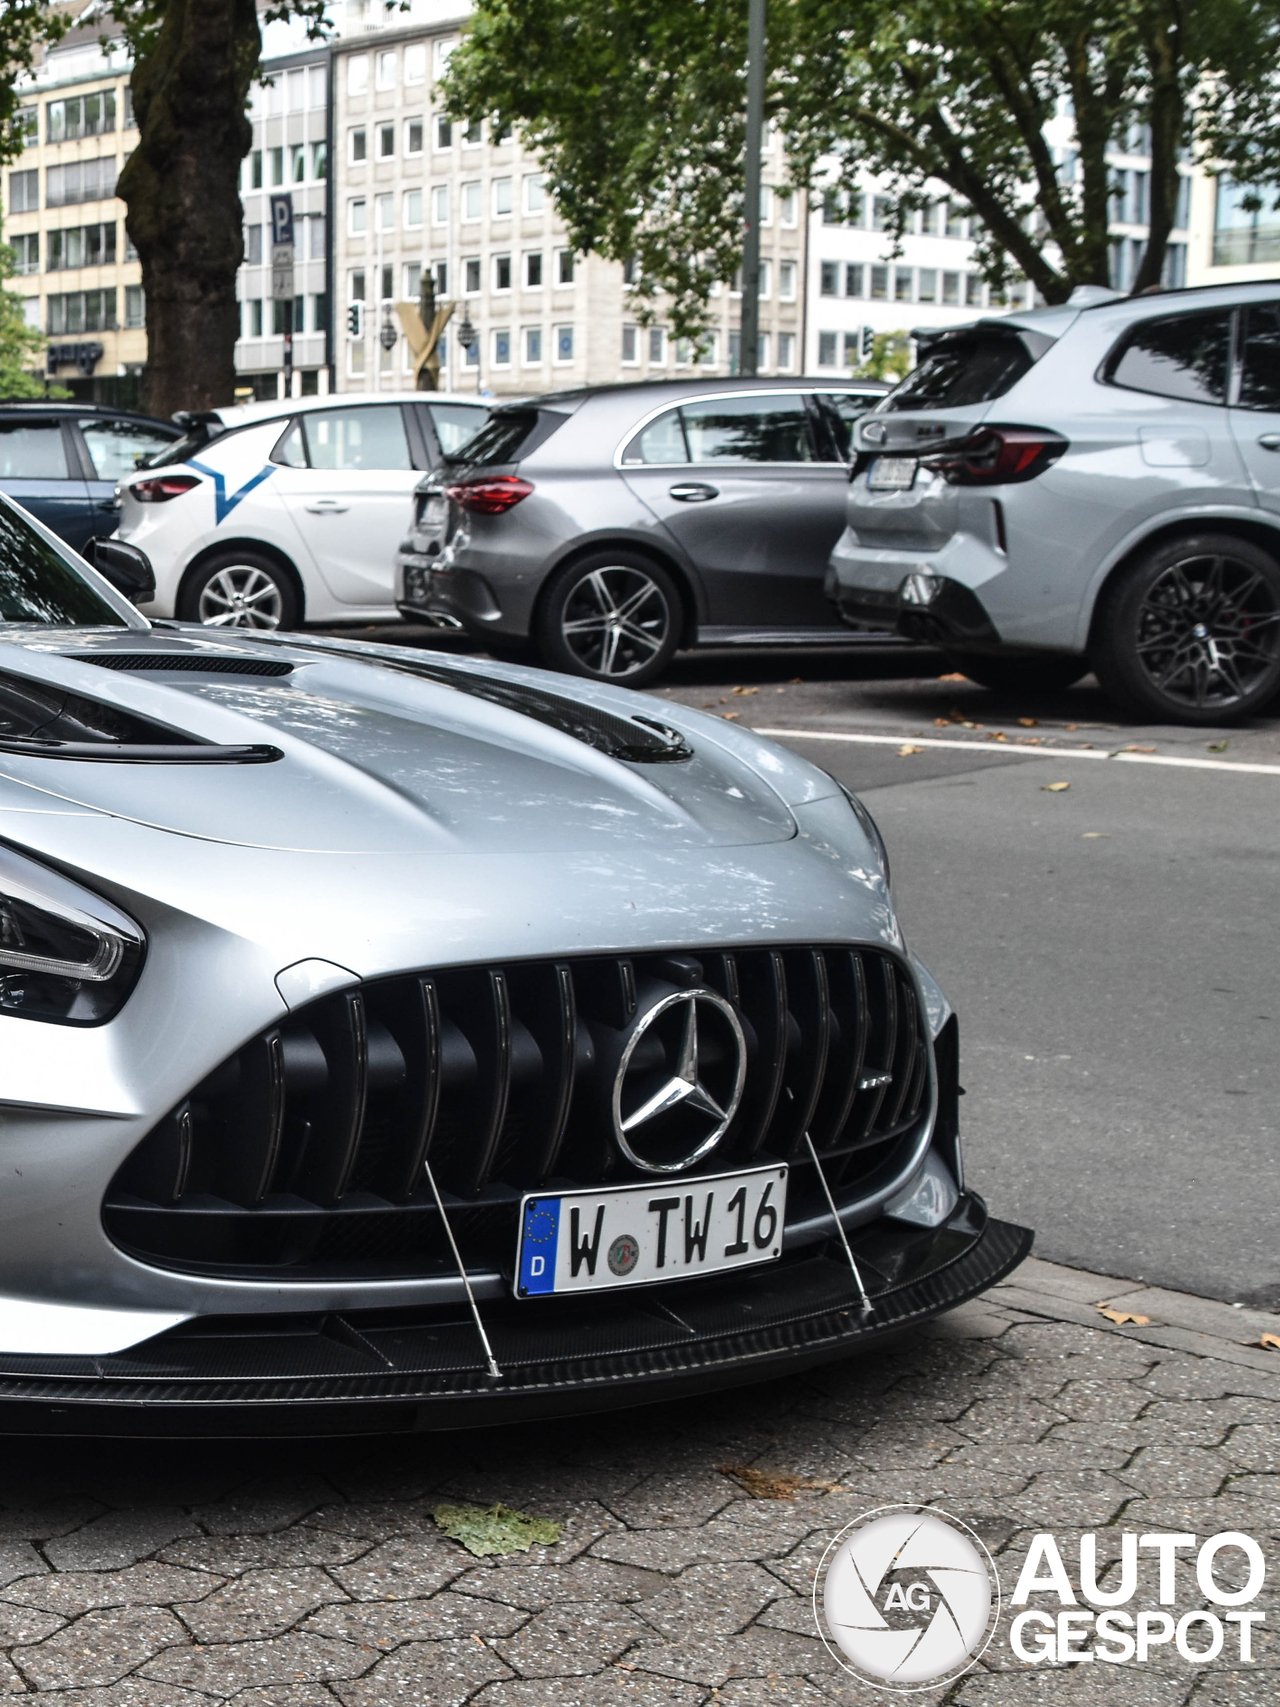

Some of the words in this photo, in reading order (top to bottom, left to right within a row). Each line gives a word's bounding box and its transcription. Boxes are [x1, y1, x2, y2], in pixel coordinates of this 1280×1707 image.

[274, 201, 289, 242] P
[570, 1204, 605, 1277] W
[530, 1255, 545, 1277] D
